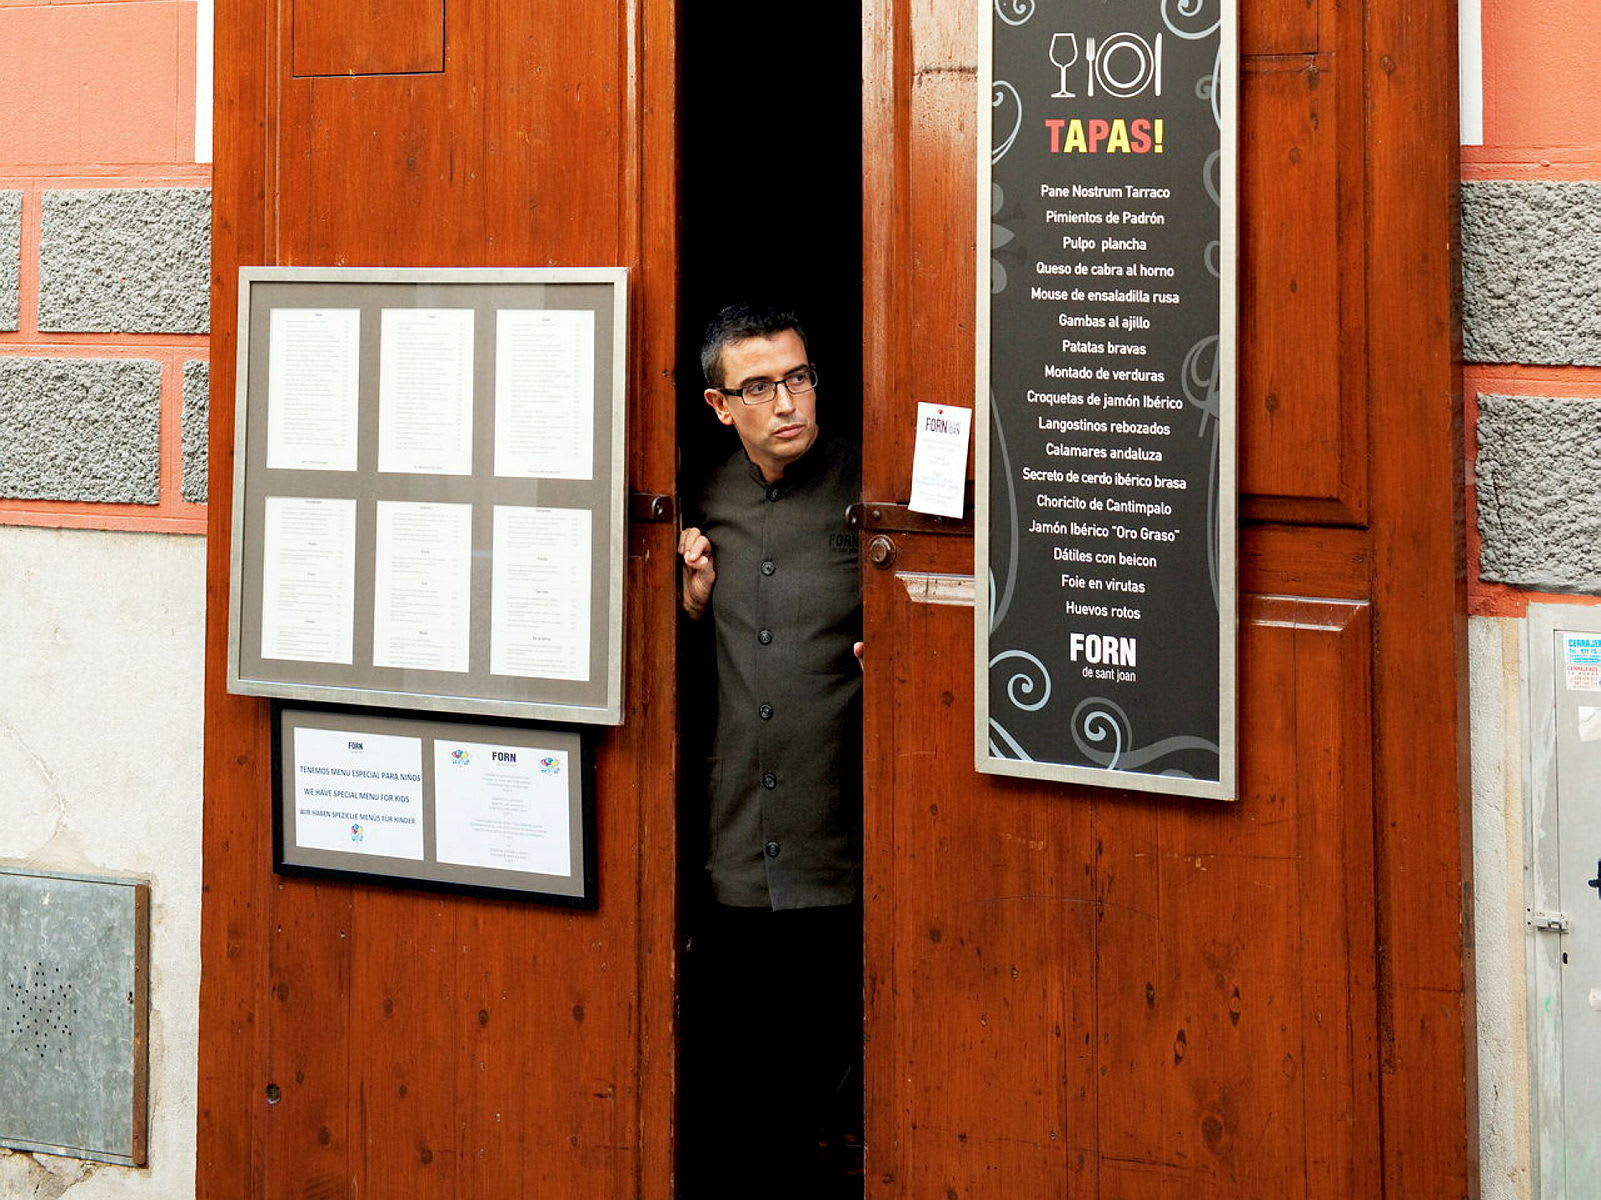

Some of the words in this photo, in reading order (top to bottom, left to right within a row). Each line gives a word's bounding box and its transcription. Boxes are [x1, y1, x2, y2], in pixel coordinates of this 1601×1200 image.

[1045, 118, 1164, 154] TAPAS!
[1040, 183, 1070, 198] Pane
[1071, 184, 1123, 198] Nostrum
[1124, 184, 1171, 199] Tarraco
[1045, 209, 1103, 224] Pimientos
[1105, 210, 1120, 225] de
[1122, 210, 1165, 225] Padrón
[1062, 235, 1096, 253] Pulpo
[1101, 236, 1147, 253] plancha
[1036, 261, 1072, 275] Queso
[1073, 262, 1089, 276] de
[1090, 262, 1124, 276] cabra
[1125, 263, 1138, 277] al
[1139, 263, 1175, 278] horno
[1030, 286, 1069, 301] Mouse
[1070, 287, 1086, 301] de
[1087, 288, 1150, 303] ensaladilla
[1152, 293, 1180, 304] rusa
[1058, 312, 1107, 328] Gambas
[1107, 315, 1120, 328] al
[1121, 315, 1151, 332] ajillo
[1062, 339, 1105, 354] Patatas
[1107, 340, 1147, 356] bravas
[1044, 364, 1094, 380] Montado
[1095, 366, 1111, 380] de
[1111, 367, 1165, 383] verduras
[1026, 389, 1085, 407] Croquetas
[1086, 392, 1102, 406] de
[1102, 392, 1141, 410] jamón
[1142, 394, 1184, 410] Ibérico
[925, 417, 948, 433] FORN
[1038, 415, 1108, 434] Langostinos
[1110, 420, 1171, 436] rebozados
[1045, 442, 1108, 459] Calamares
[1109, 446, 1163, 462] andaluza
[1022, 466, 1064, 482] Secreto
[1065, 469, 1080, 483] de
[1080, 471, 1113, 486] cerdo
[1114, 472, 1153, 488] ibérico
[1154, 474, 1187, 490] brasa
[1036, 493, 1087, 510] Choricito
[1088, 497, 1104, 511] de
[1106, 497, 1172, 517] Cantimpalo
[1028, 519, 1068, 535] Jamón
[1070, 521, 1110, 538] Ibérico
[1053, 546, 1093, 563] Dátiles
[1095, 553, 1116, 565] con
[1118, 551, 1157, 568] beicon
[1061, 573, 1086, 589] Foie
[1088, 579, 1103, 590] en
[1105, 577, 1146, 594] virutas
[1065, 600, 1109, 617] Huevos
[1111, 605, 1141, 620] rotos
[1070, 632, 1137, 667] FORN
[1082, 666, 1094, 678] de
[1095, 669, 1115, 680] sant
[1116, 669, 1137, 683] joan
[348, 742, 364, 750] FORN
[492, 751, 517, 763] FORN
[300, 765, 330, 776] TENEMOS
[352, 770, 380, 779] ESPECIAL
[381, 772, 399, 780] PARA
[400, 772, 421, 782] NIÑOS
[304, 788, 314, 796] WE
[315, 789, 332, 797] HAVE
[333, 790, 358, 799] SPECIAL
[359, 792, 379, 801] MENU
[380, 793, 394, 802] FOR
[395, 795, 410, 803] KIDS
